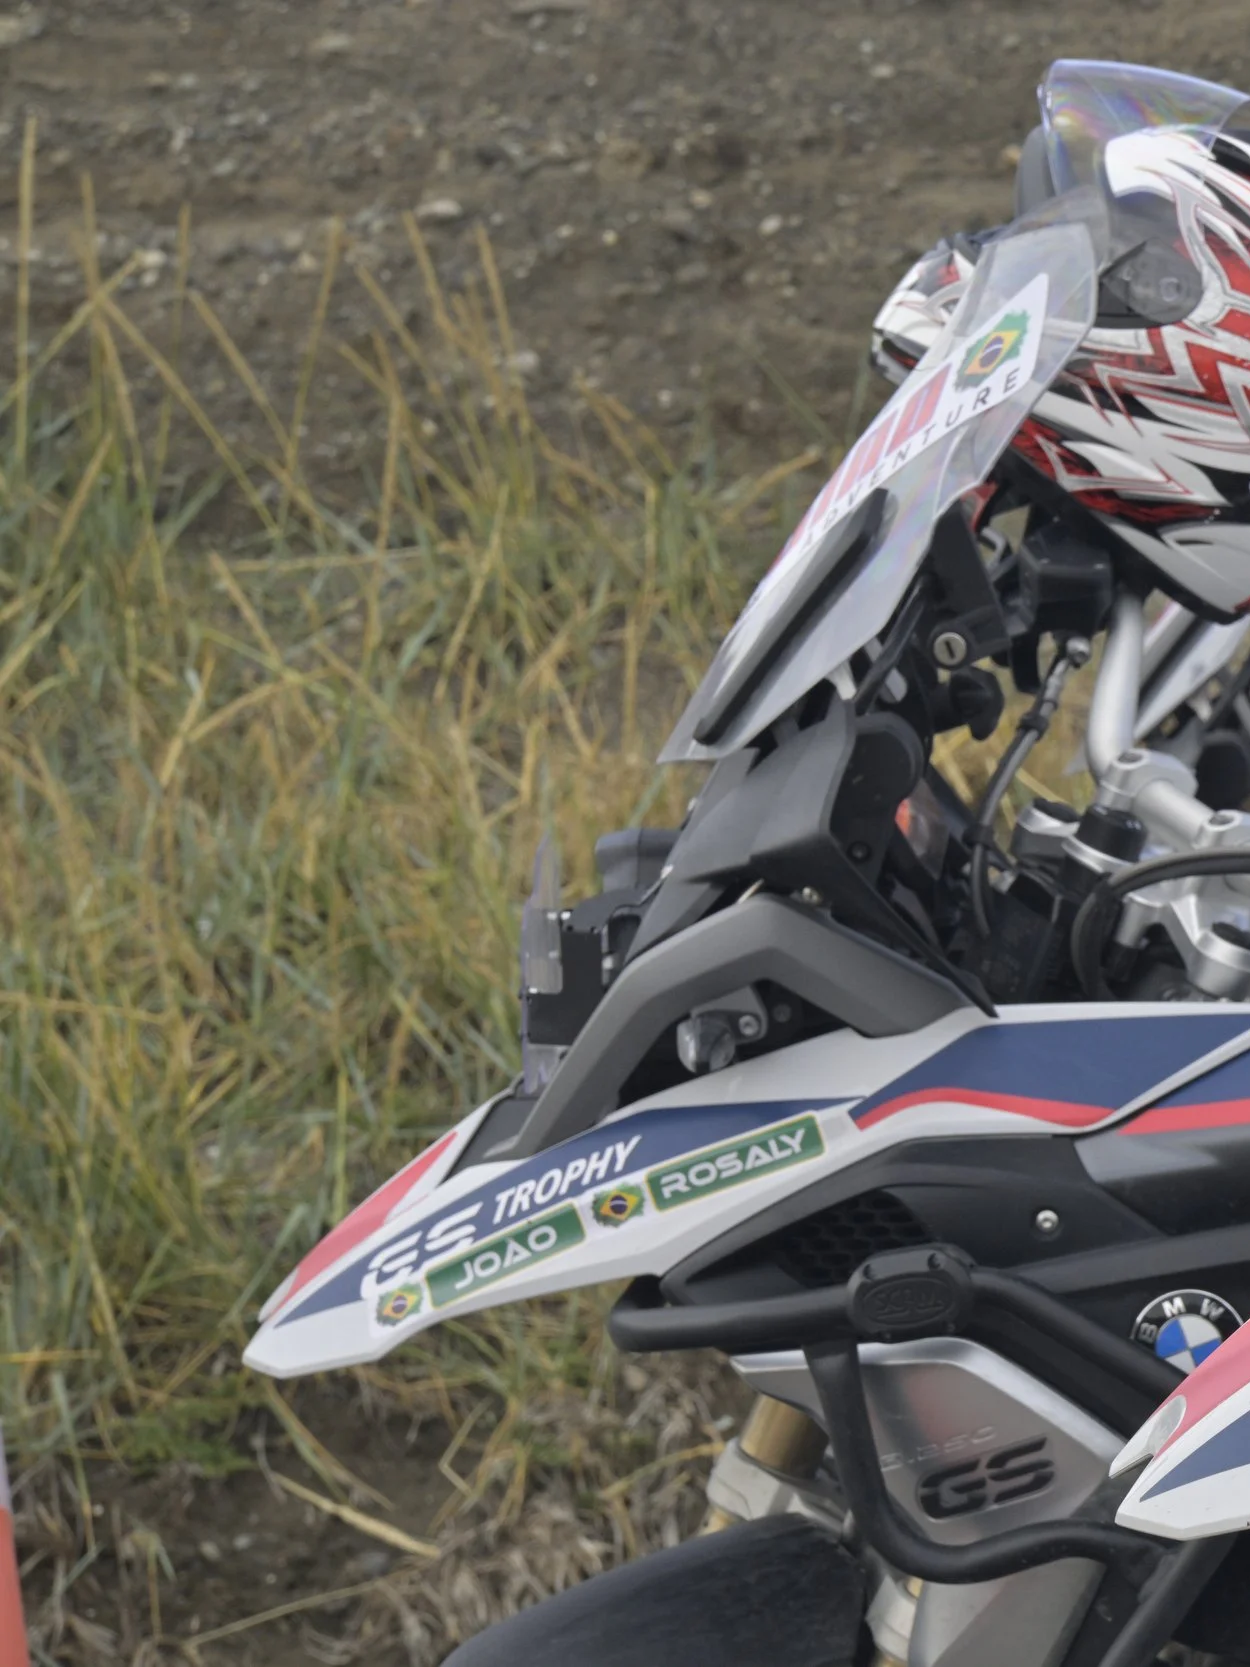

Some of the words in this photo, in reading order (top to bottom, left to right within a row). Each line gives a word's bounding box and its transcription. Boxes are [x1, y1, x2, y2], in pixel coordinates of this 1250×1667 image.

[660, 1129, 805, 1199] ROSALY
[360, 1200, 484, 1301] GS
[491, 1134, 642, 1225] TROPHY
[1138, 1296, 1225, 1344] BMW
[917, 1435, 1056, 1522] GS
